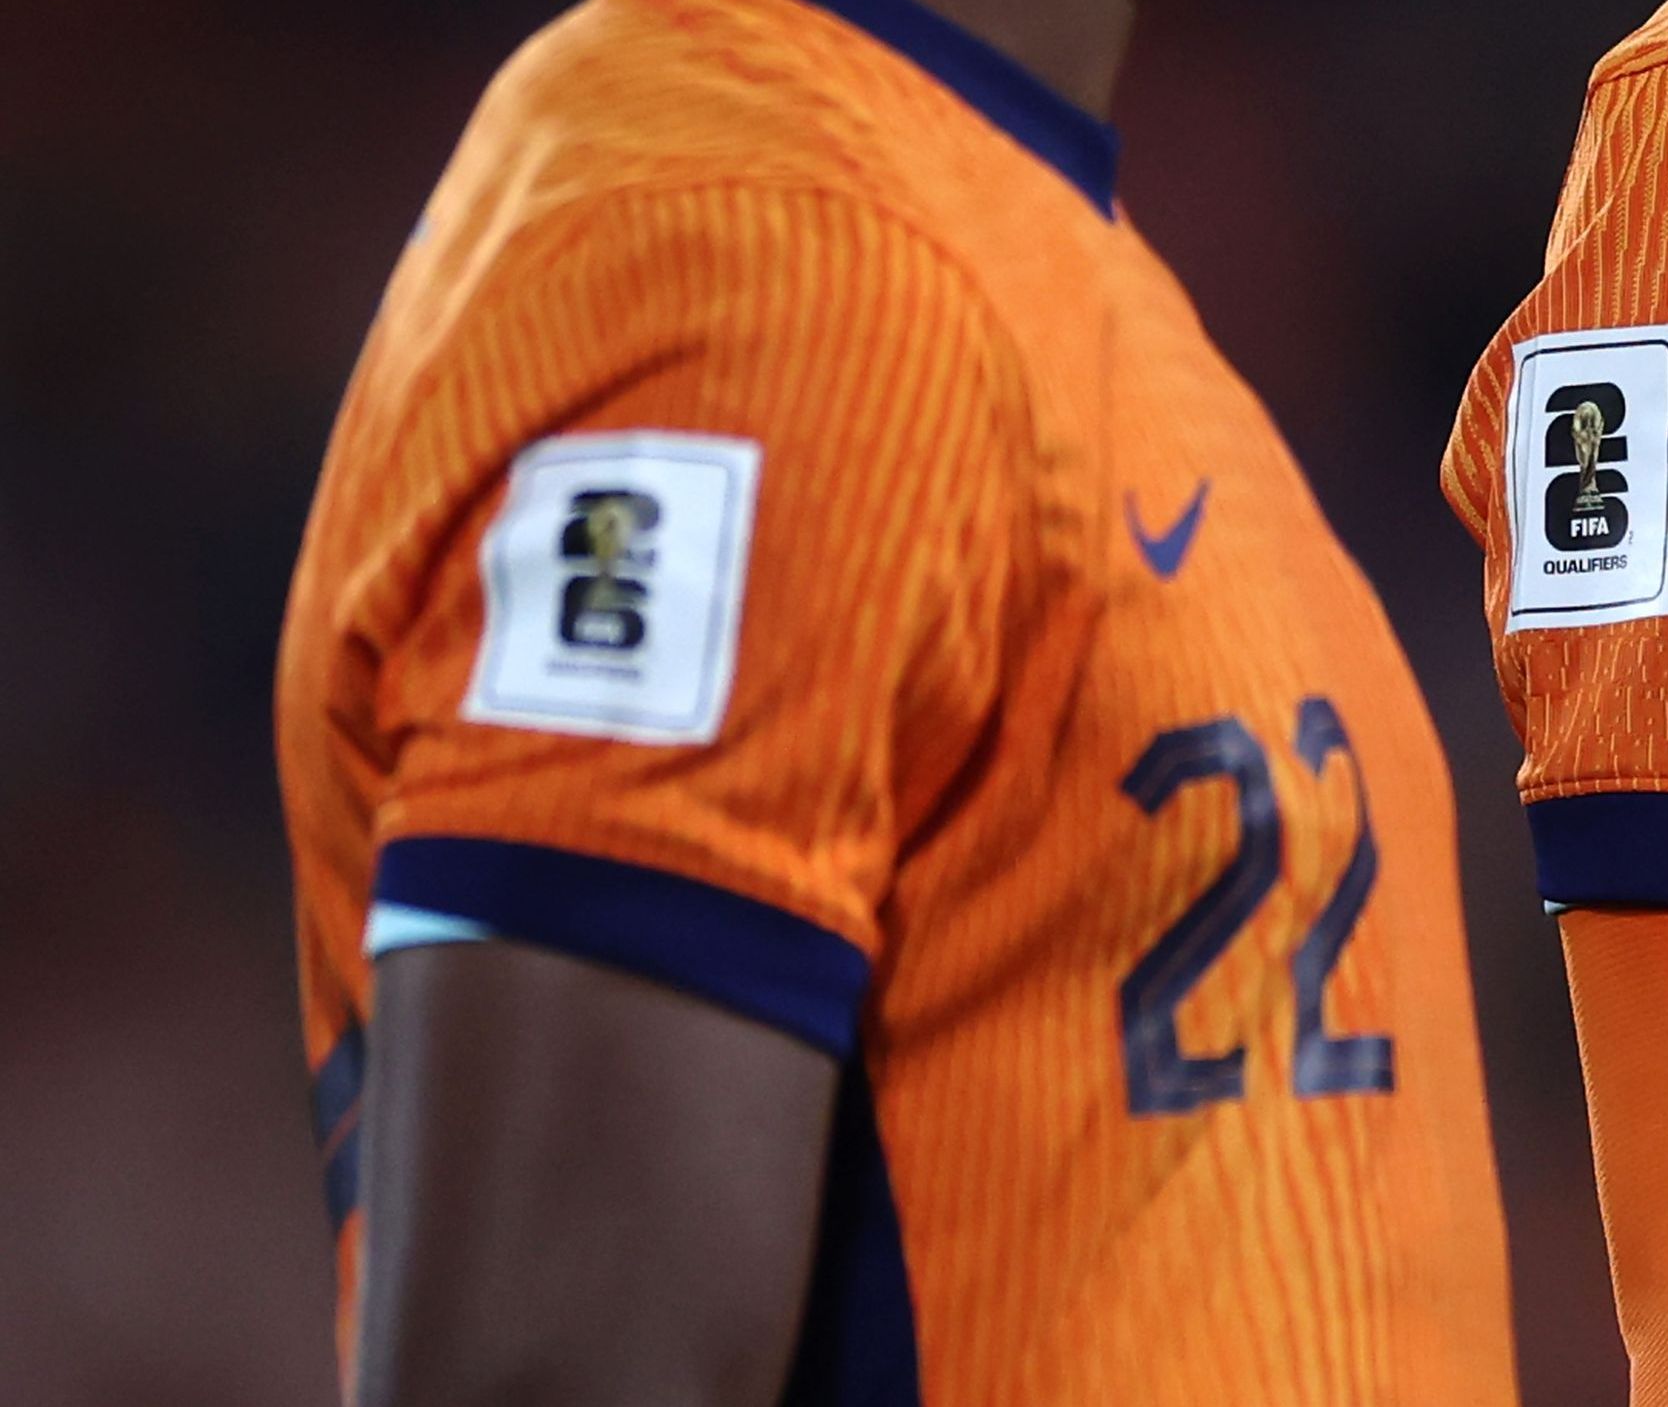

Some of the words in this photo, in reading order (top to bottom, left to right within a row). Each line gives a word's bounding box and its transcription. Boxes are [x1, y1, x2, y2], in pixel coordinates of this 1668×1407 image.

[1570, 516, 1610, 538] FIFA
[1543, 554, 1628, 575] QUALIFIERS
[1120, 694, 1395, 1118] 22
